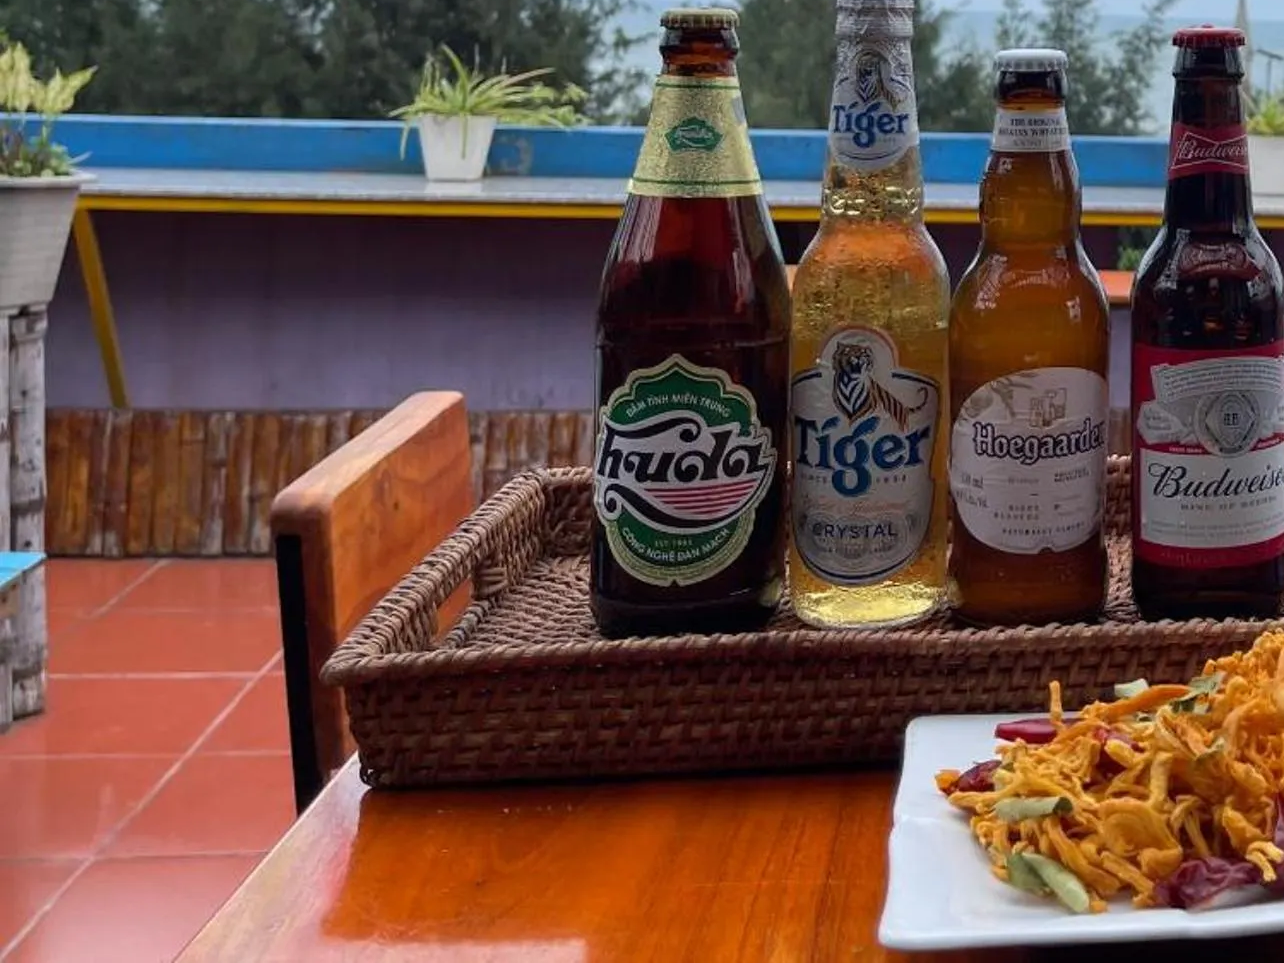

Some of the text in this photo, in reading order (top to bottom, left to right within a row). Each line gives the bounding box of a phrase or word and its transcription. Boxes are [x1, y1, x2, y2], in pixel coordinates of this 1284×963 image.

[832, 101, 909, 148] Tiger
[794, 415, 931, 497] Tiger
[972, 417, 1105, 466] Hoegaarde
[812, 521, 898, 539] CRYSTAL
